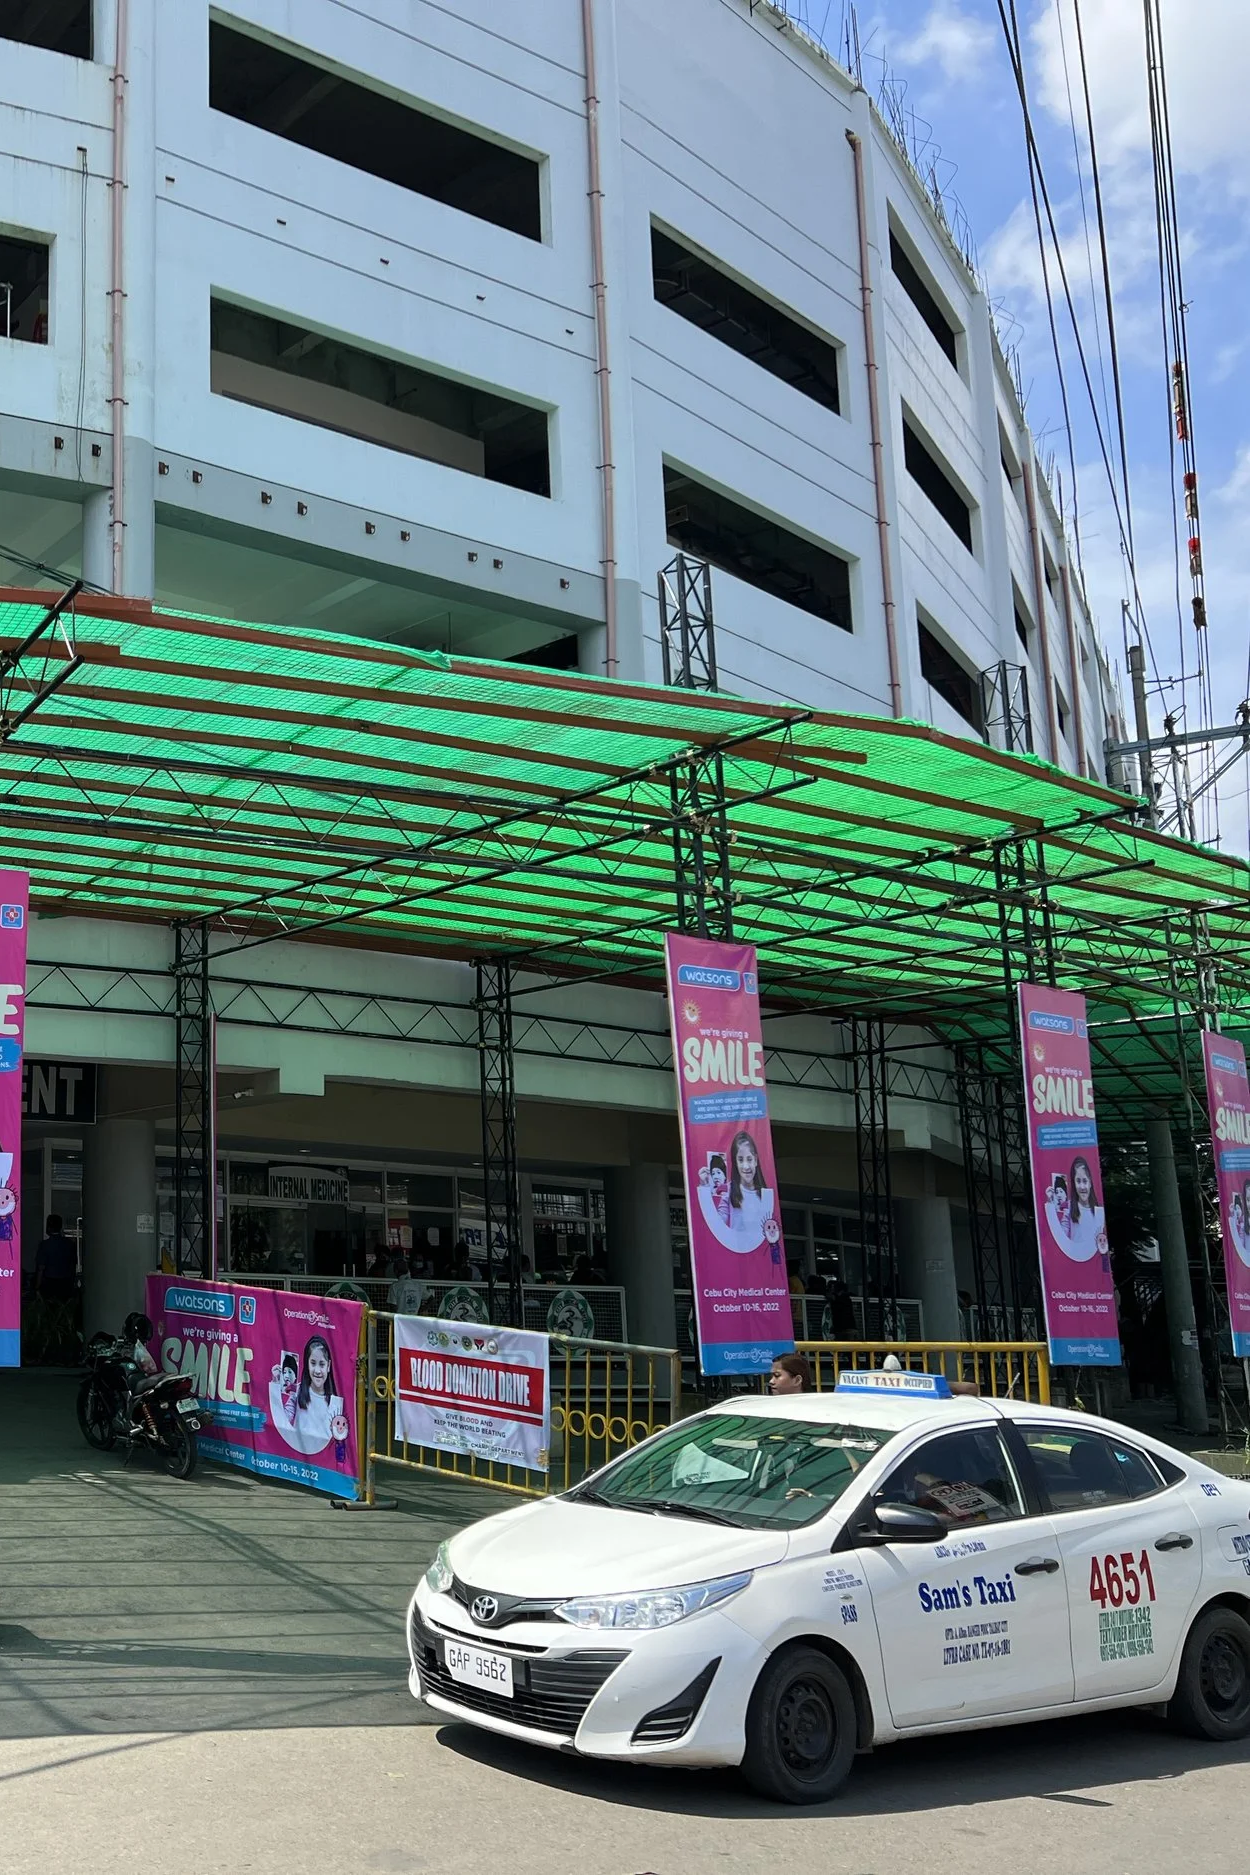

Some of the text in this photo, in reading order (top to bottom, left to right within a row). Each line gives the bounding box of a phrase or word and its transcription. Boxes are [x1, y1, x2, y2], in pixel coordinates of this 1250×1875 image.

[686, 970, 732, 986] watsons
[1034, 1016, 1069, 1030] watsons
[700, 1028, 720, 1037] we're
[722, 1029, 744, 1039] giving
[683, 1037, 765, 1087] SMILE
[1032, 1074, 1095, 1118] SMILE
[270, 1176, 348, 1202] INTERNAL MEDICINE
[704, 1288, 786, 1298] Cebu City Medical Center
[1066, 1291, 1077, 1300] City
[175, 1294, 225, 1313] watsons
[713, 1304, 741, 1312] October
[763, 1303, 779, 1312] 2022
[284, 1308, 310, 1319] Operation
[183, 1326, 238, 1343] we're giving a
[161, 1337, 254, 1406] SMILE
[410, 1357, 530, 1407] BLOOD DONATION DRIVE
[842, 1375, 932, 1389] VACANT TAXI OCCUPIED
[459, 1416, 479, 1424] BLOOD
[447, 1421, 458, 1429] THE
[459, 1423, 480, 1432] WORLD
[481, 1428, 506, 1438] BEATING
[301, 1468, 319, 1481] 2022
[1089, 1549, 1156, 1609] 4651
[918, 1573, 1016, 1613] Sam's Taxi
[1135, 1606, 1151, 1624] 1342
[449, 1649, 507, 1682] GAP 9562
